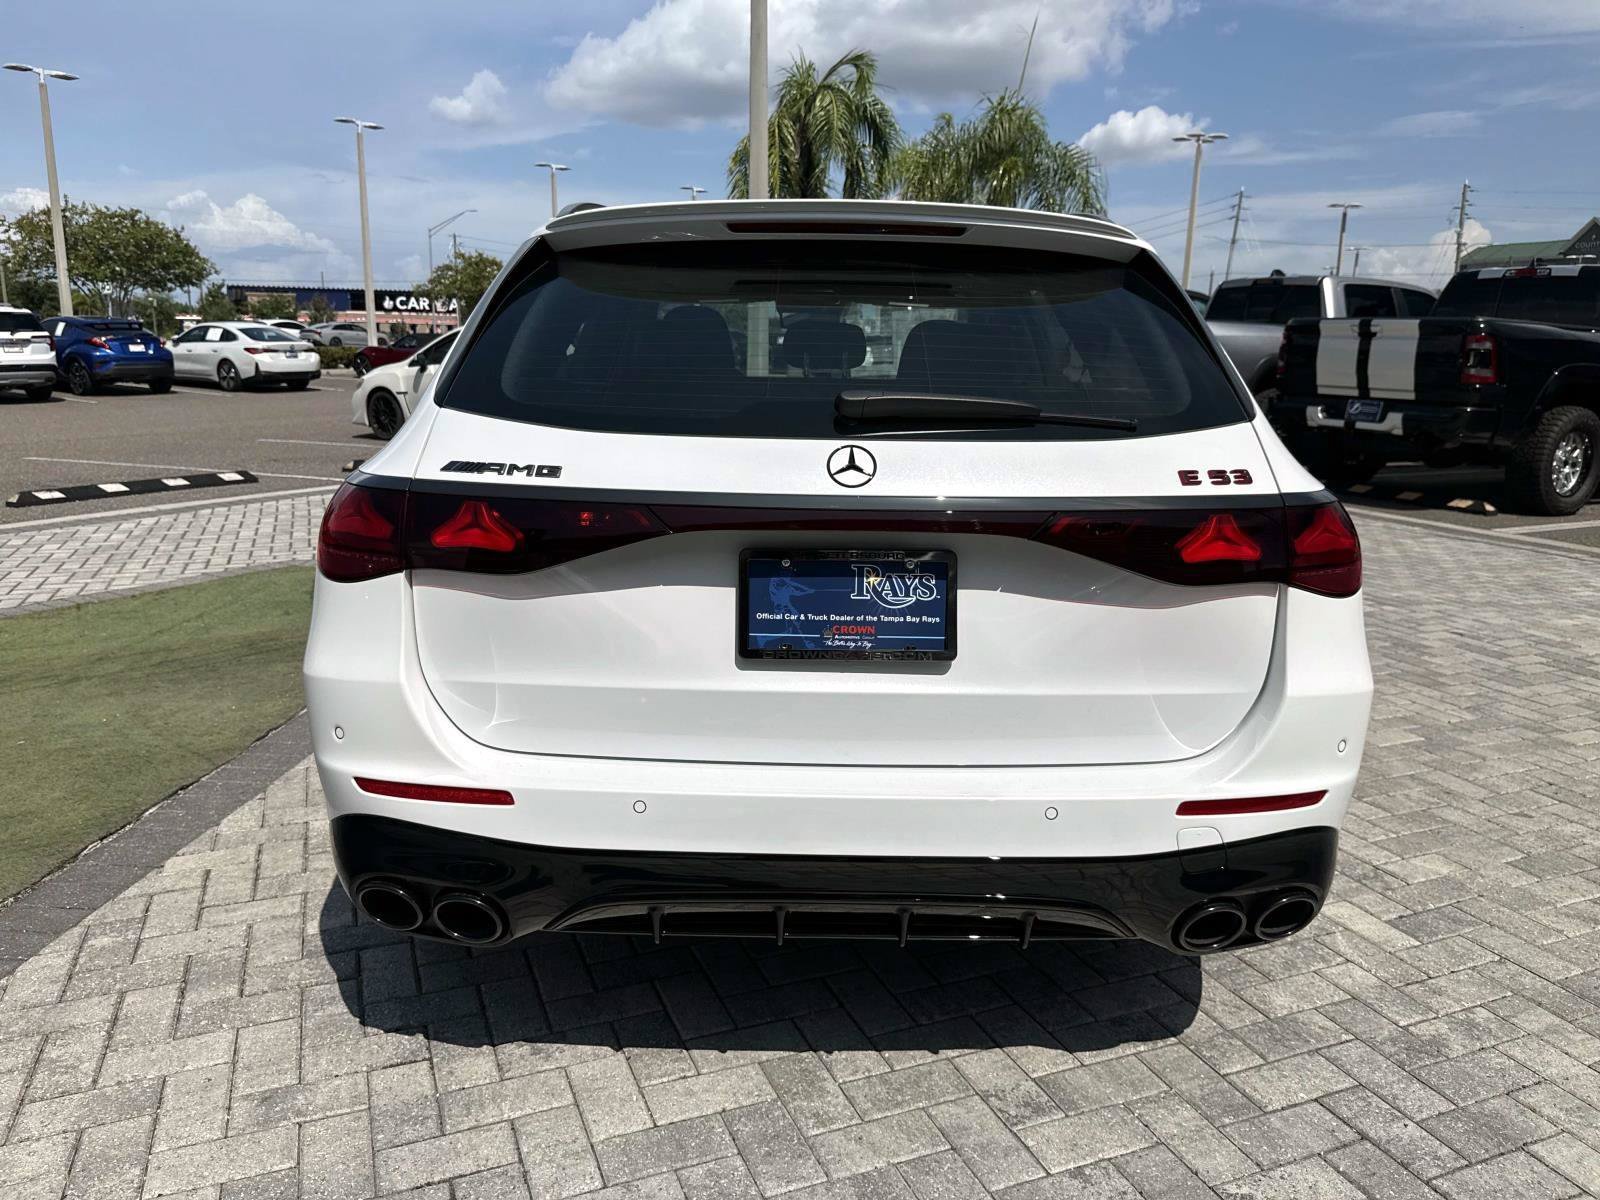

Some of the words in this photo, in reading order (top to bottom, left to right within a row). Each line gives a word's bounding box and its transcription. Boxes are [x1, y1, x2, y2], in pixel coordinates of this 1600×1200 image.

[395, 296, 430, 311] CAR
[474, 462, 562, 478] AMG
[1177, 469, 1202, 486] E
[1207, 469, 1253, 486] 53
[850, 564, 937, 608] RAYS
[756, 612, 783, 620] Official
[807, 613, 828, 621] Truck
[833, 625, 875, 634] CROWN
